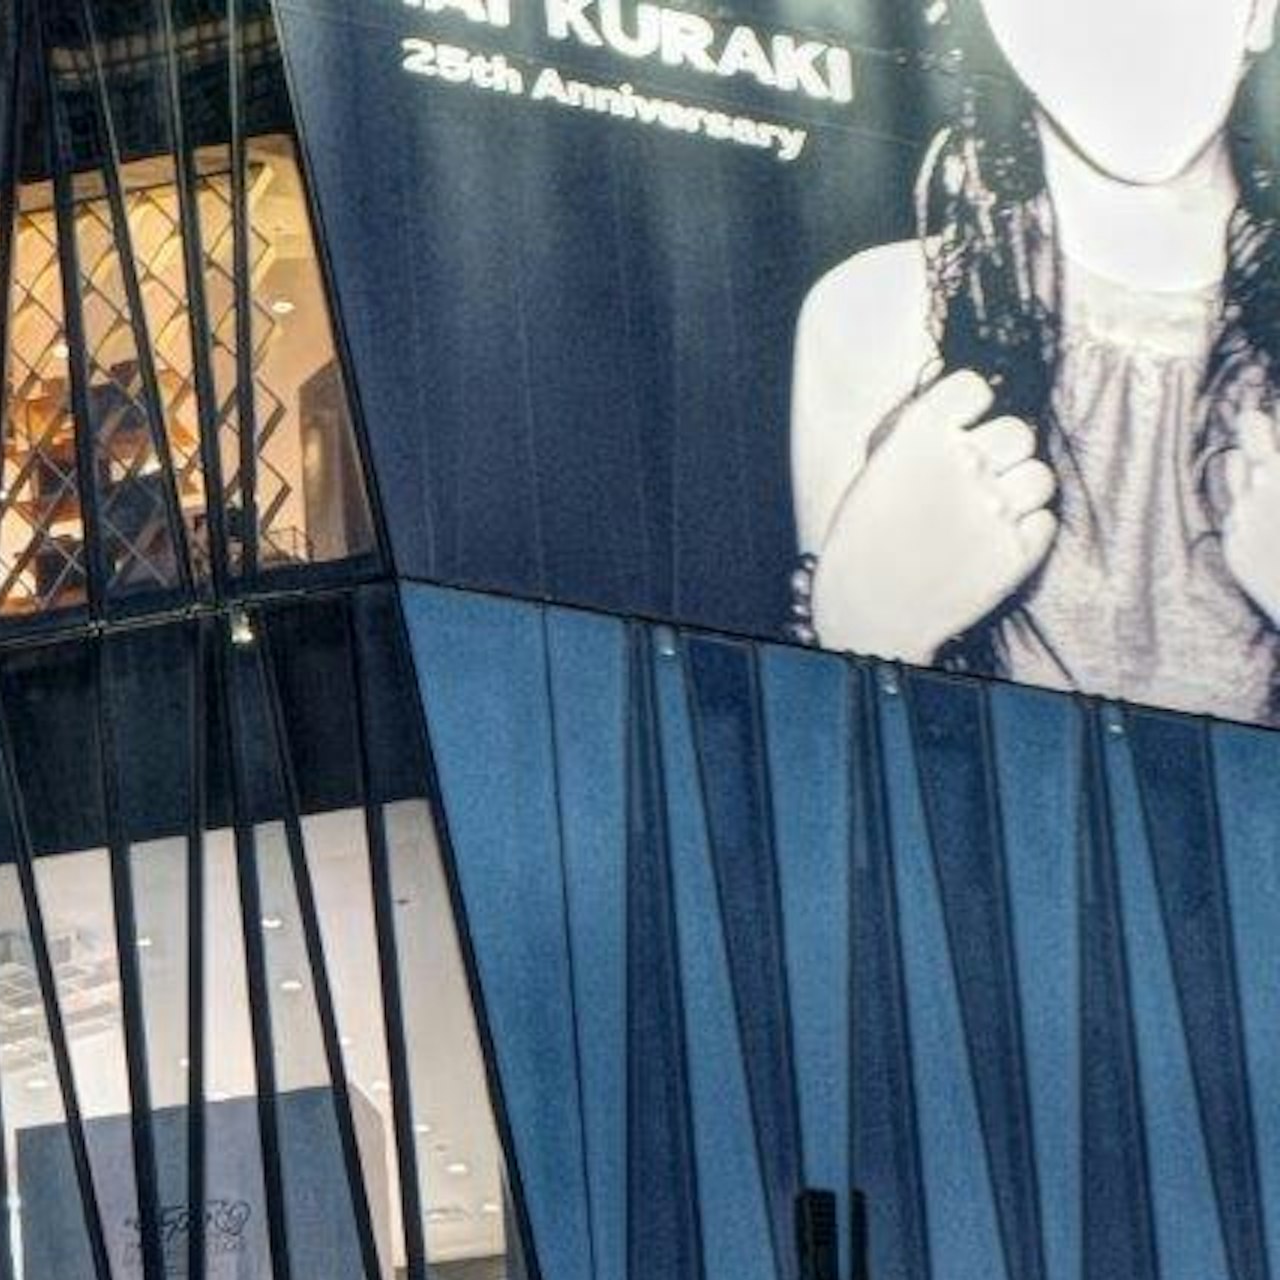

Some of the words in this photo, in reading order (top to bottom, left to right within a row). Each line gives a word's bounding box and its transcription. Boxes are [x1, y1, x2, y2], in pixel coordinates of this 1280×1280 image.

[400, 38, 524, 96] 25th
[531, 67, 808, 161] Anniversary
[546, 0, 853, 103] KURAKI
